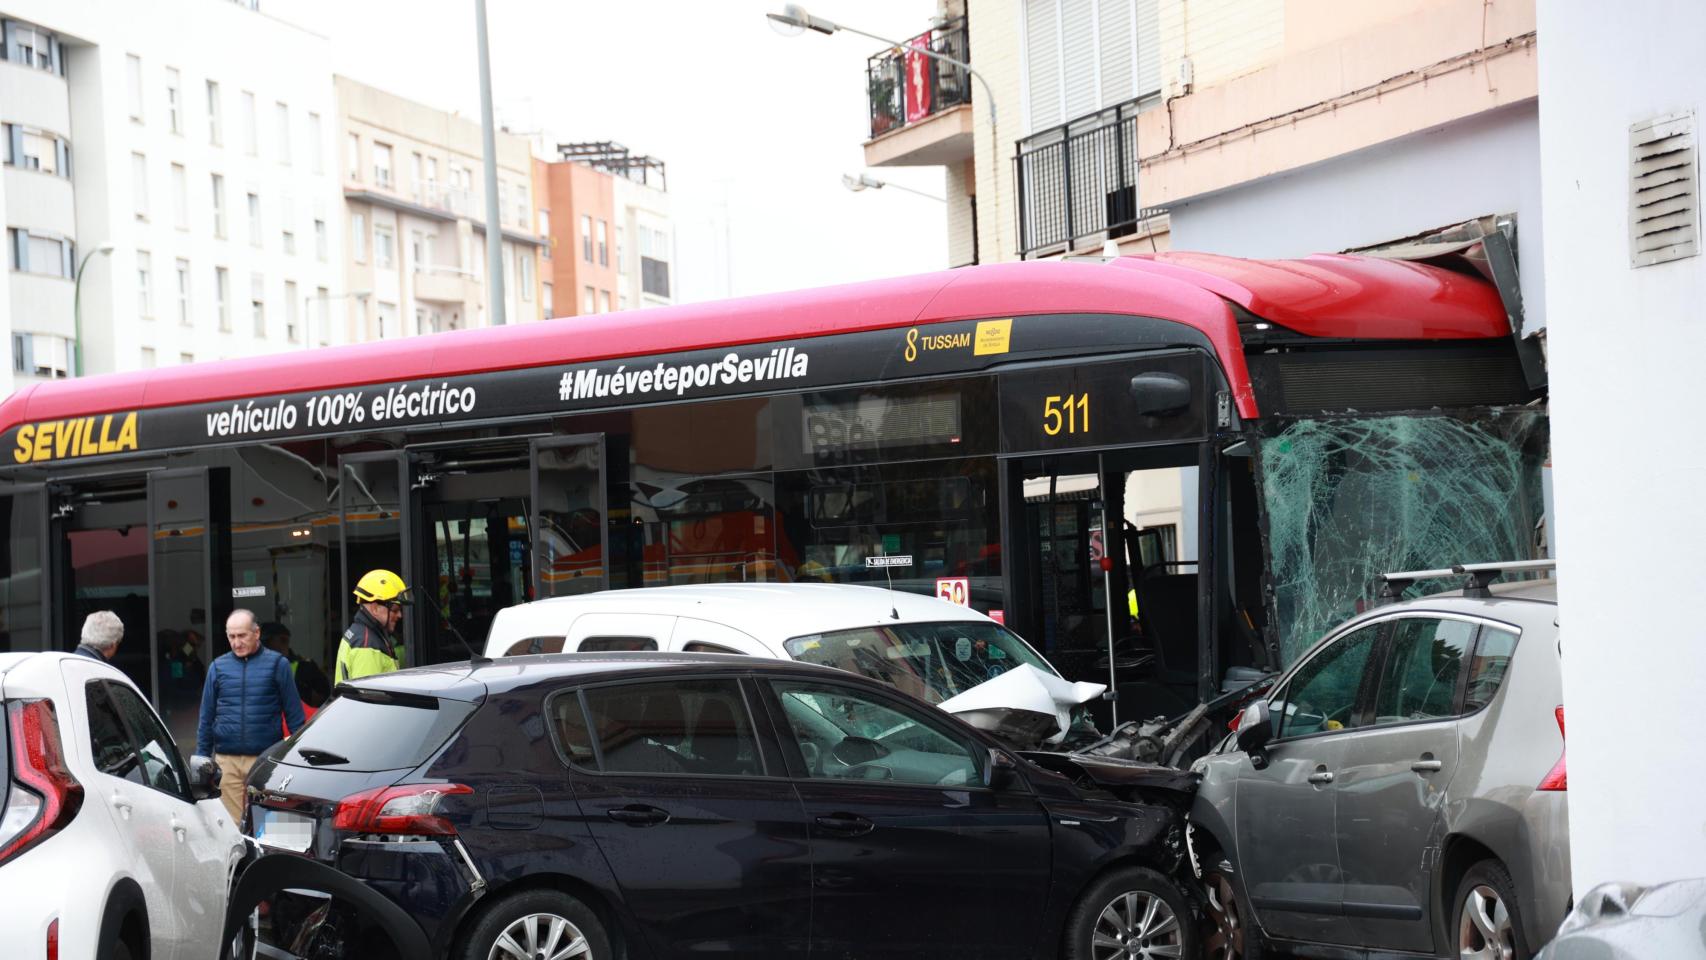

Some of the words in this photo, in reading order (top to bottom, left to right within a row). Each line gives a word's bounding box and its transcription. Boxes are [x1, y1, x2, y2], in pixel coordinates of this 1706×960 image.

[922, 333, 971, 350] TUSSAM
[559, 347, 808, 400] #MuéveteporSevilla
[206, 398, 298, 437] vehículo
[305, 391, 365, 428] 100%
[371, 384, 477, 420] eléctrico
[1043, 392, 1090, 436] 511
[13, 411, 139, 464] SEVILLA
